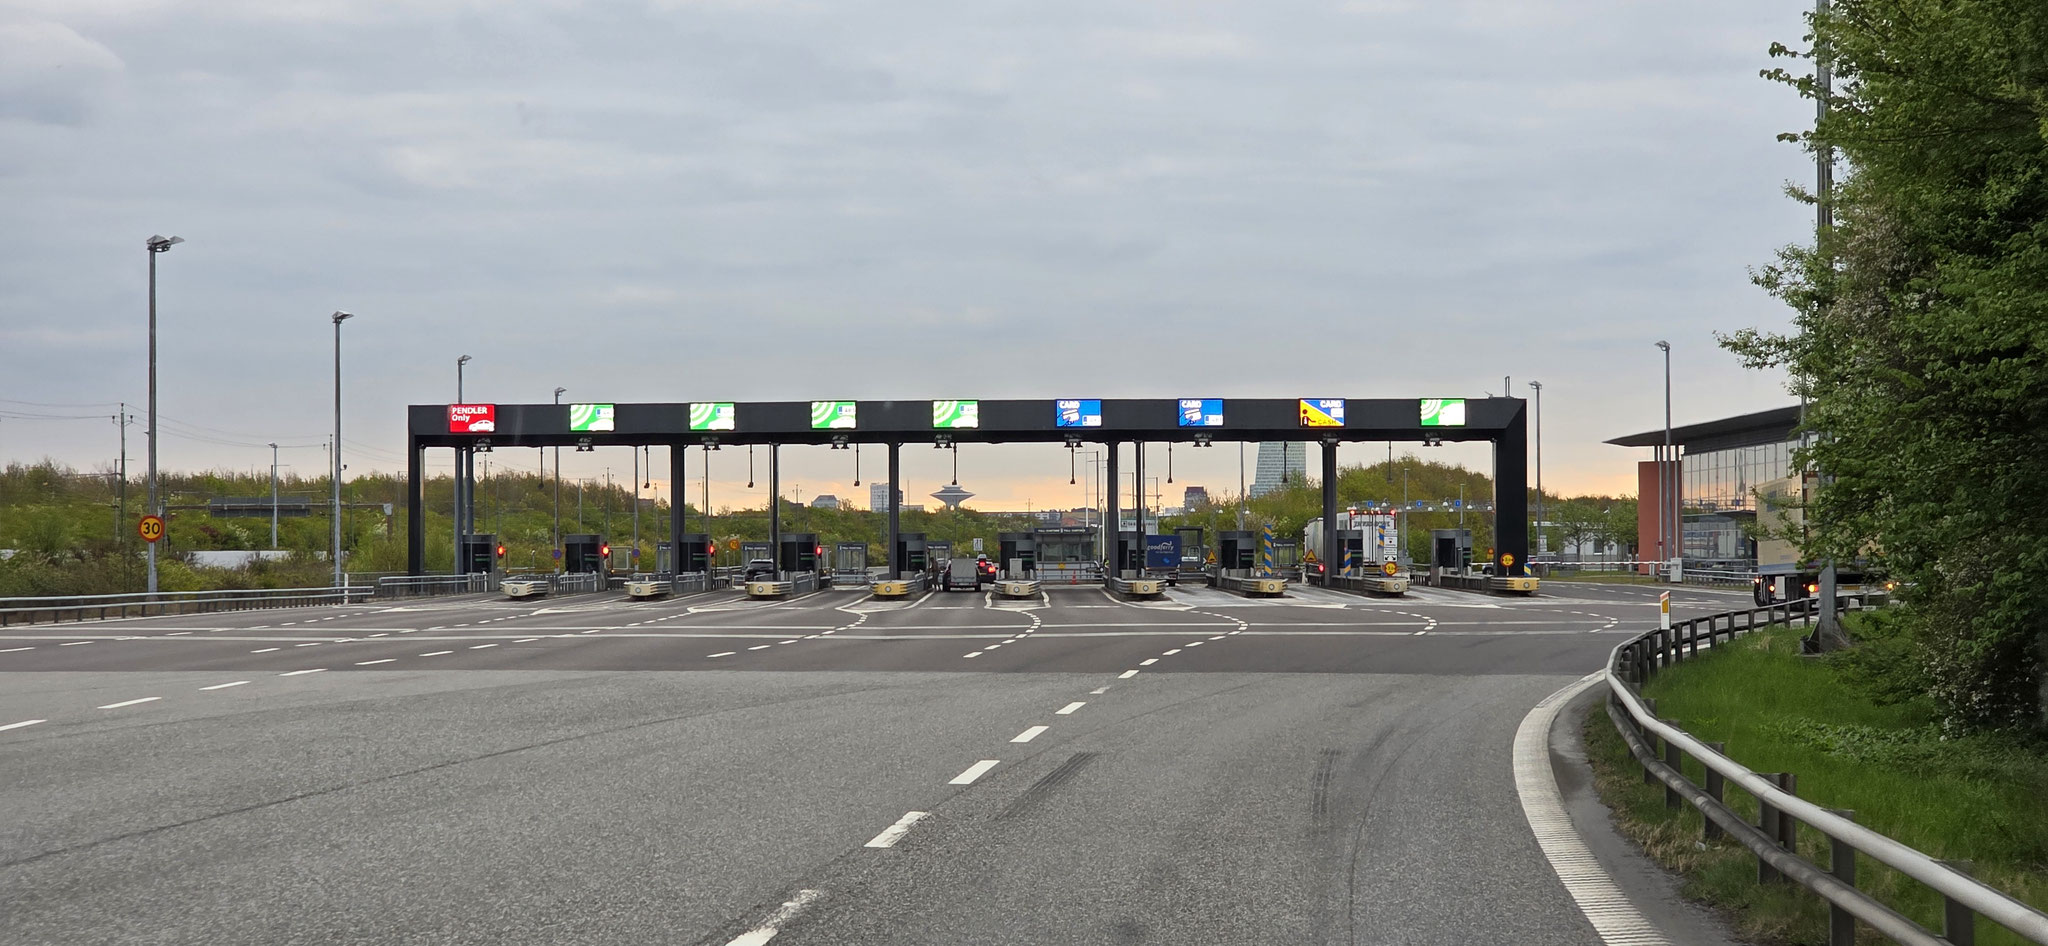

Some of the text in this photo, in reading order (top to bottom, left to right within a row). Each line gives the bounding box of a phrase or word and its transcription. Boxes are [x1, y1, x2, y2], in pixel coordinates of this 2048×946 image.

[1058, 400, 1081, 409] CARD
[1181, 400, 1202, 408] CARD
[1320, 400, 1343, 409] CARD
[452, 406, 488, 415] PENDLER
[451, 414, 471, 423] Only
[143, 522, 160, 535] 30
